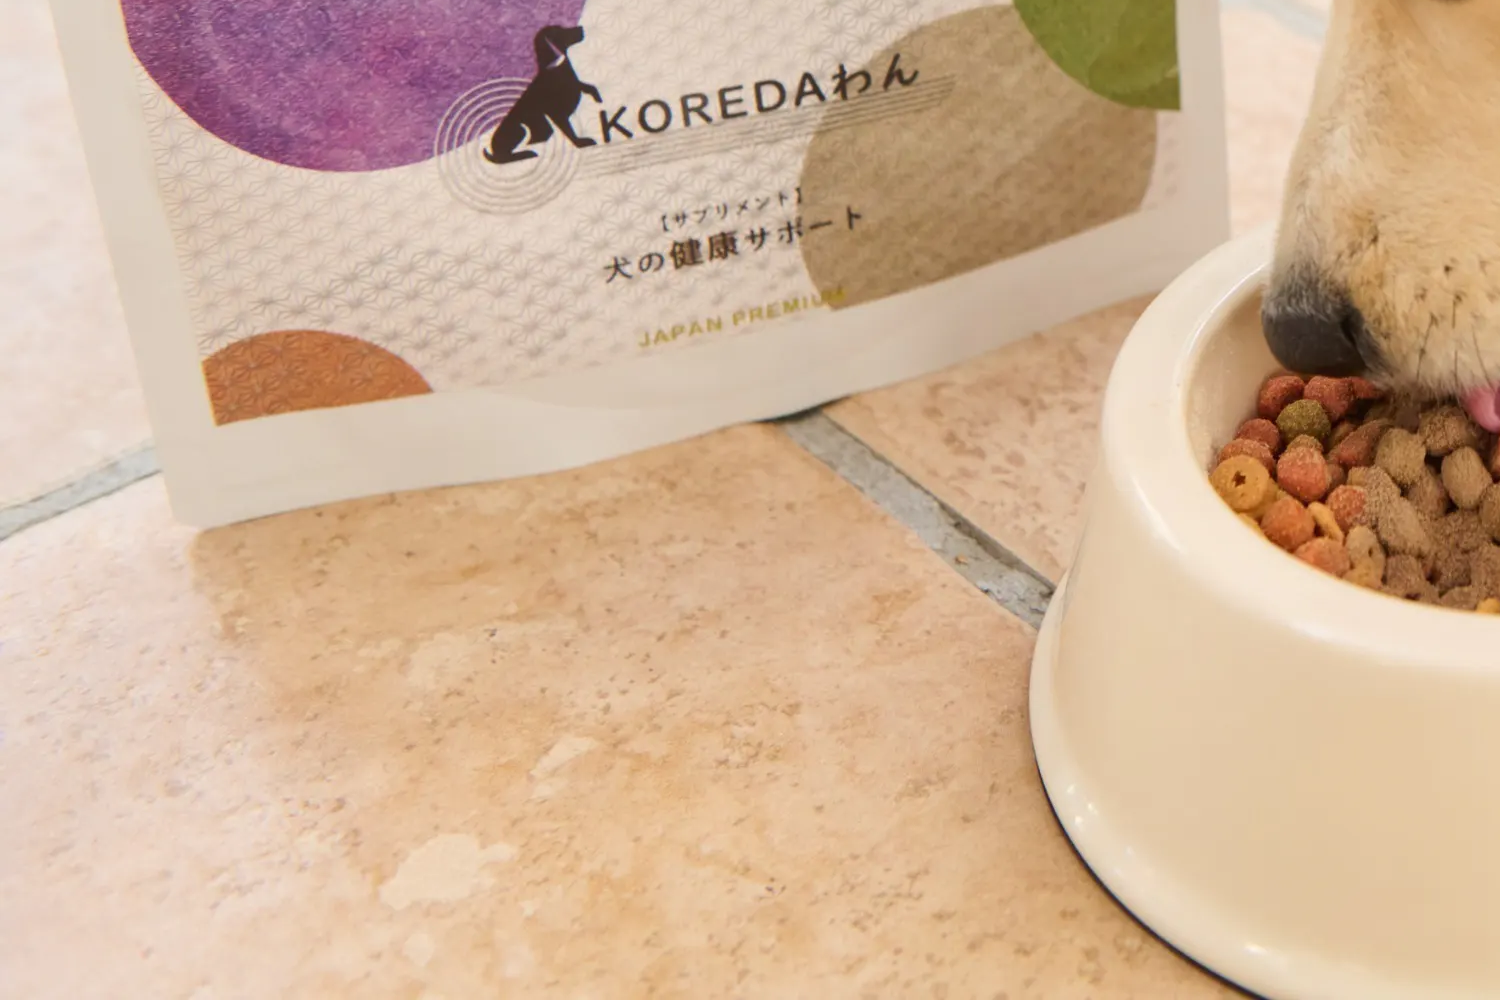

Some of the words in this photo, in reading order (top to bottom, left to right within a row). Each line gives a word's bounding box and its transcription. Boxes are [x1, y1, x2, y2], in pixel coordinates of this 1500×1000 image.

[600, 53, 919, 143] KOREDAわん
[604, 206, 862, 283] 犬の健康サポート
[638, 316, 723, 347] JAPAN
